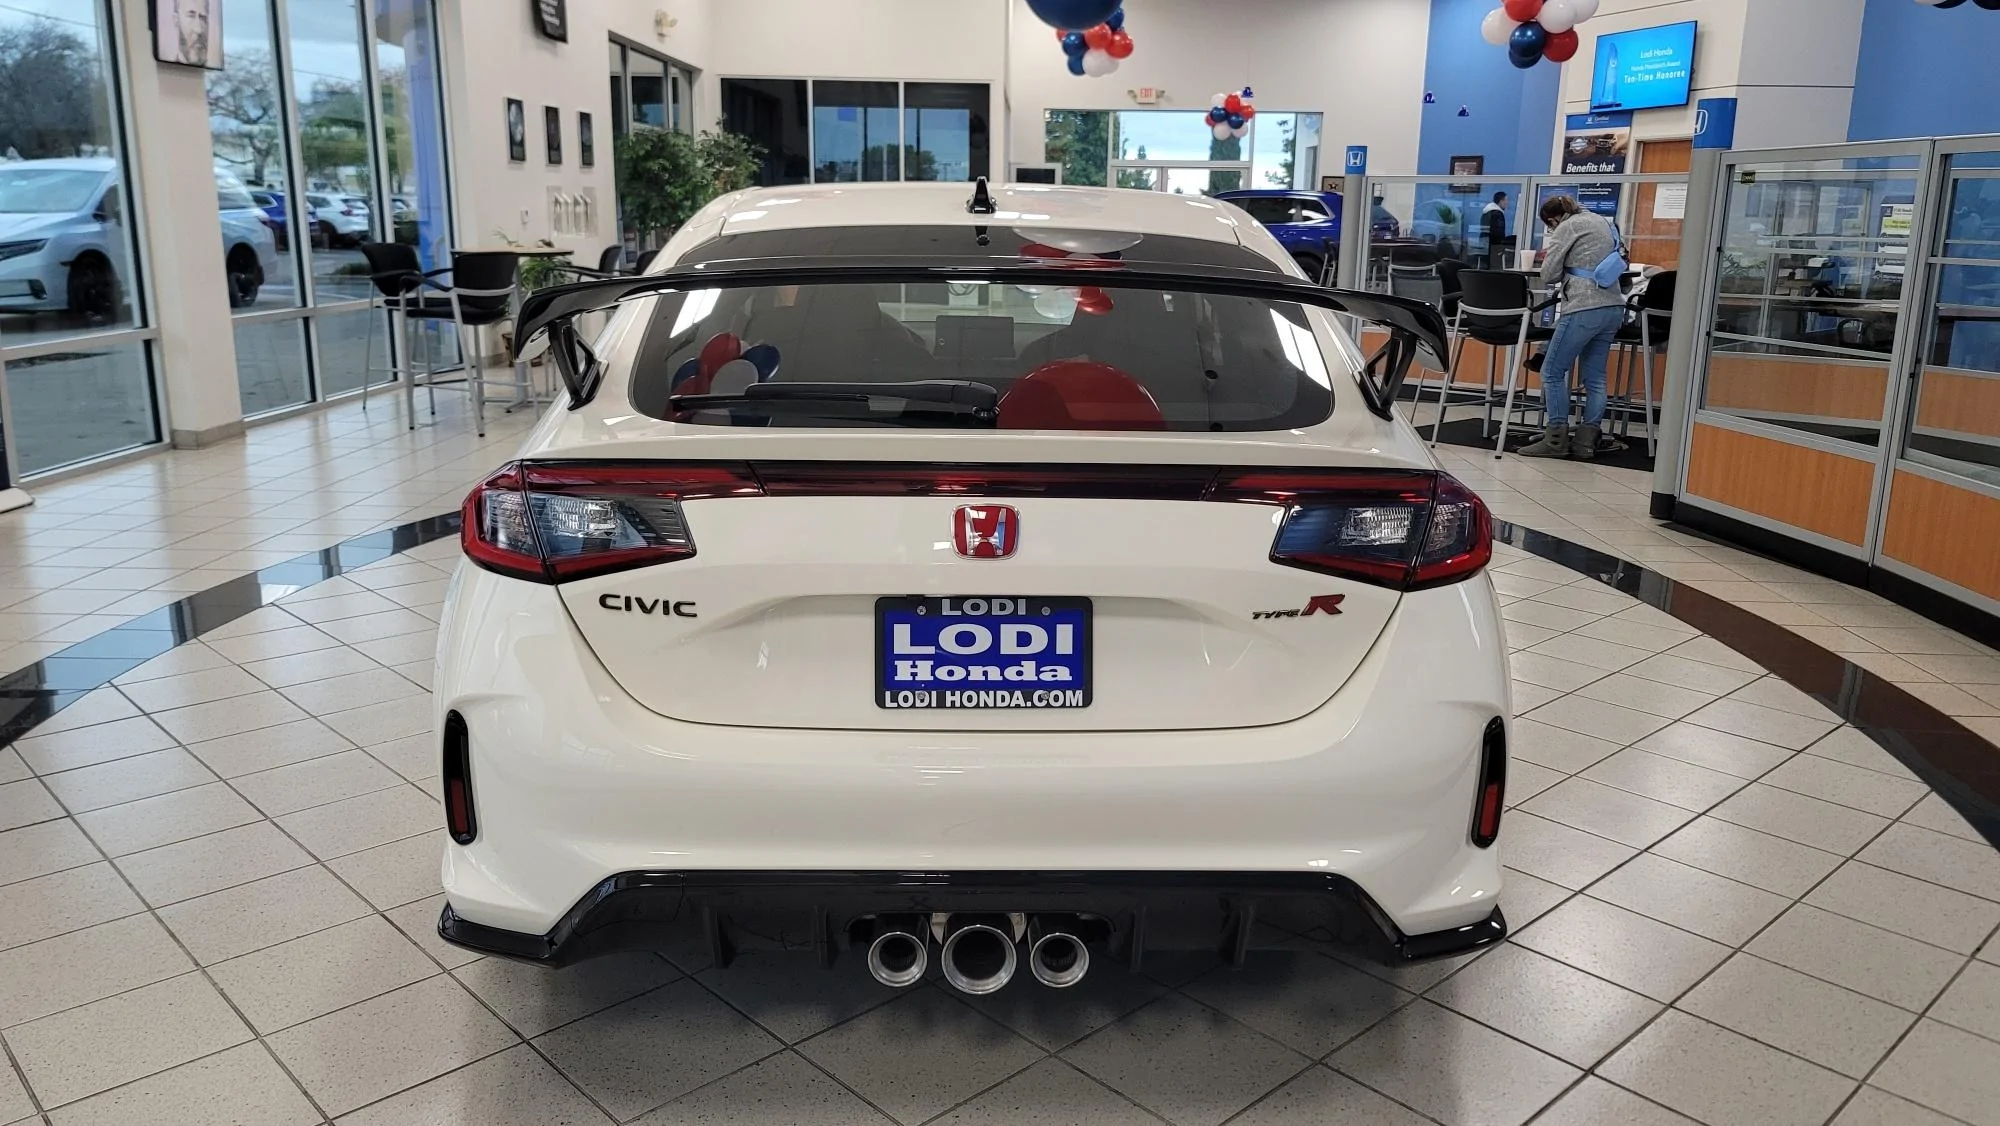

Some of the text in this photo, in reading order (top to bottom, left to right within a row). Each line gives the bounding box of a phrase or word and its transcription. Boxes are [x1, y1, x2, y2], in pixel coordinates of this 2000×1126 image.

[1640, 47, 1673, 58] Lodi Honda
[1624, 70, 1686, 83] Ten-Time Honoree
[1566, 161, 1615, 173] Benefits that
[599, 593, 697, 617] CIVIC
[941, 598, 1027, 616] LODI
[1252, 593, 1345, 620] TYPE R
[893, 623, 1074, 655] LODI
[894, 660, 1073, 682] Honda
[885, 689, 1083, 708] LODI HONDA.COM
